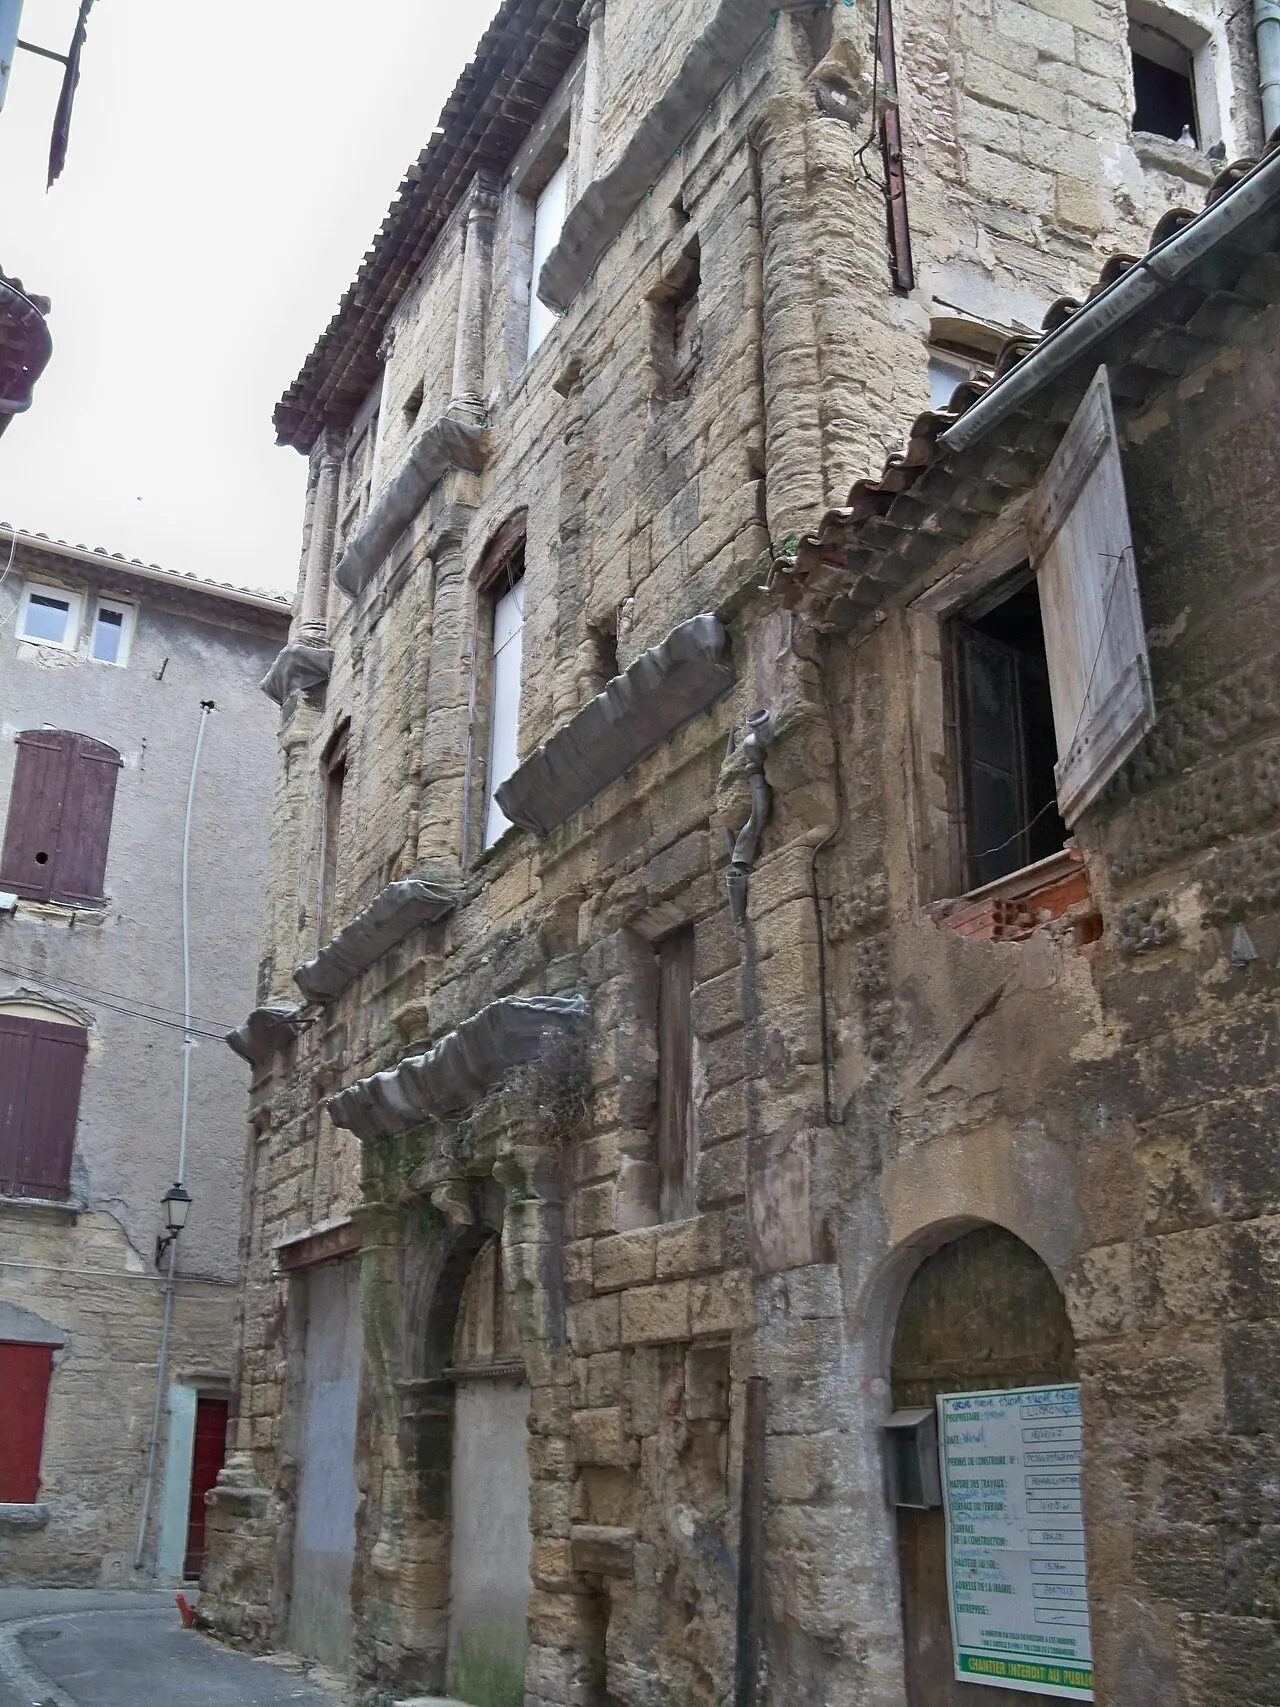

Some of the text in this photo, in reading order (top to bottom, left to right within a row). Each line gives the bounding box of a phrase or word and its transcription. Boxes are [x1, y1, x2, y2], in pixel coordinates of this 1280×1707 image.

[968, 1658, 1007, 1675] CHANTIER
[1009, 1663, 1046, 1680] INTERDIT
[1048, 1669, 1060, 1682] AU
